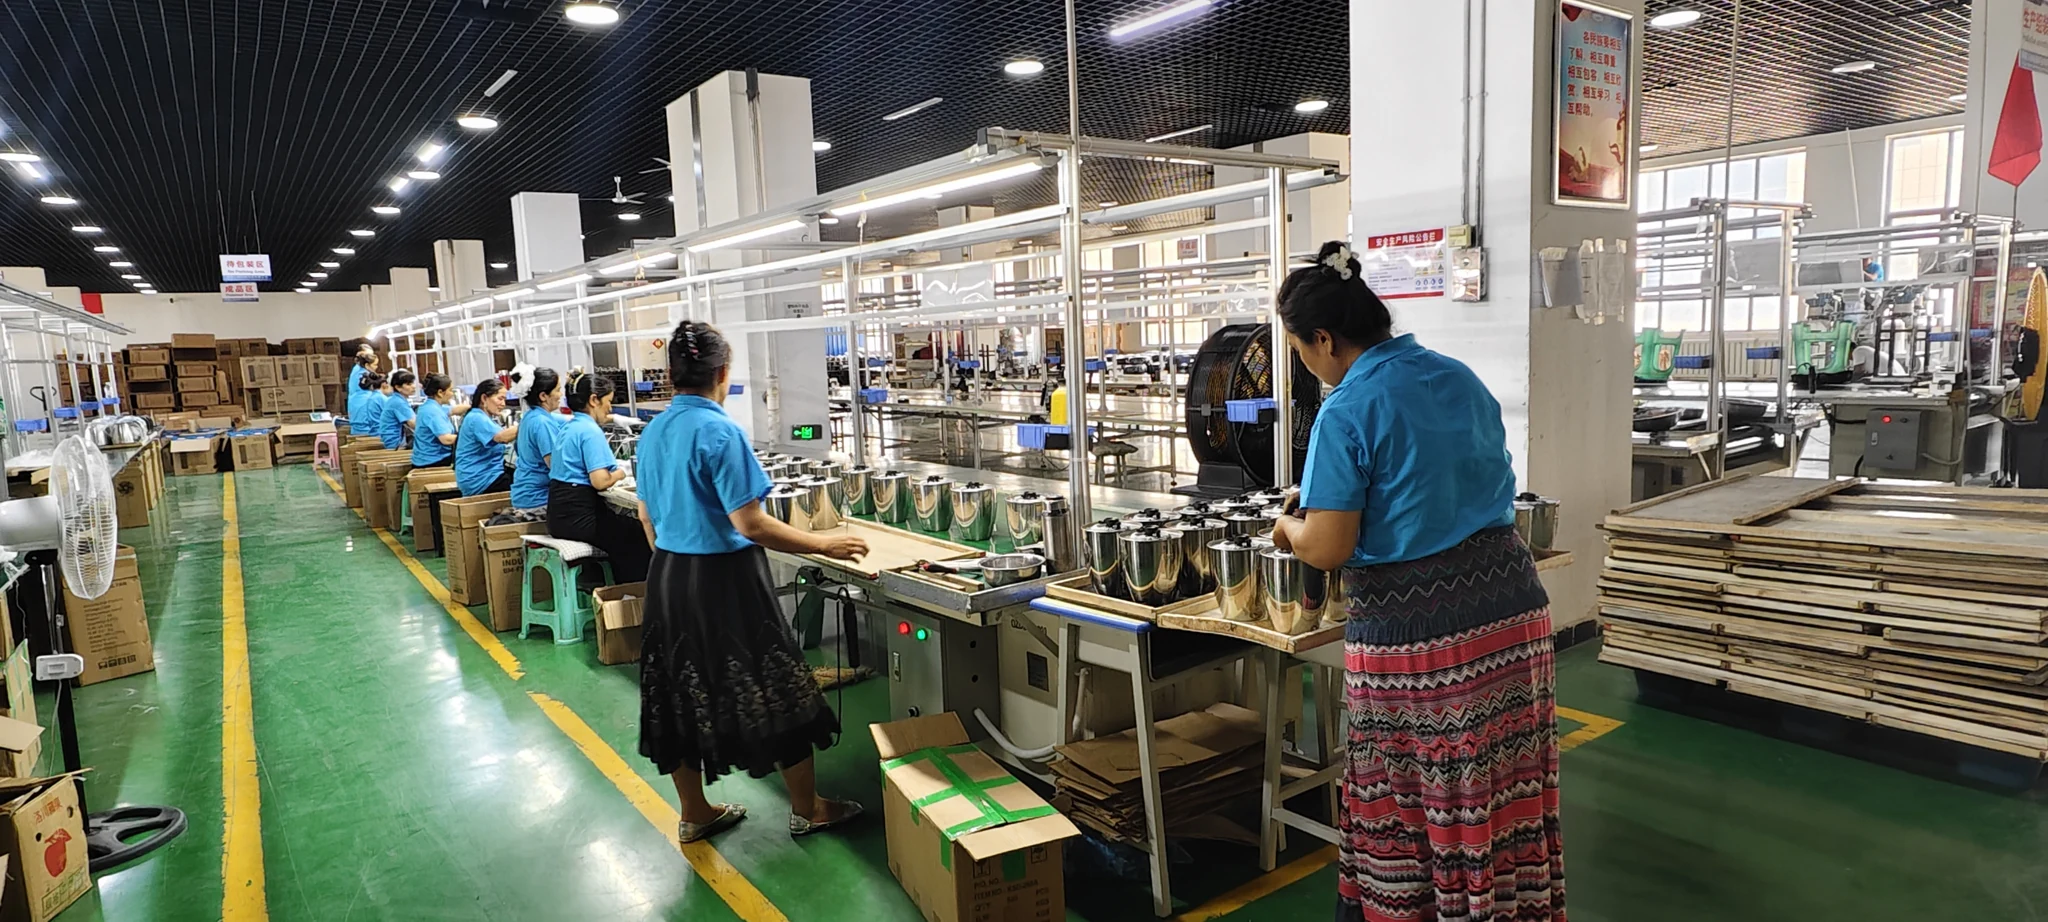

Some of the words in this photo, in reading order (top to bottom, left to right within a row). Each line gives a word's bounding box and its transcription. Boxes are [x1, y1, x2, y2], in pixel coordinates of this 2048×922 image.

[1583, 31, 1622, 51] 各民族要相互
[225, 285, 254, 293] 成品区
